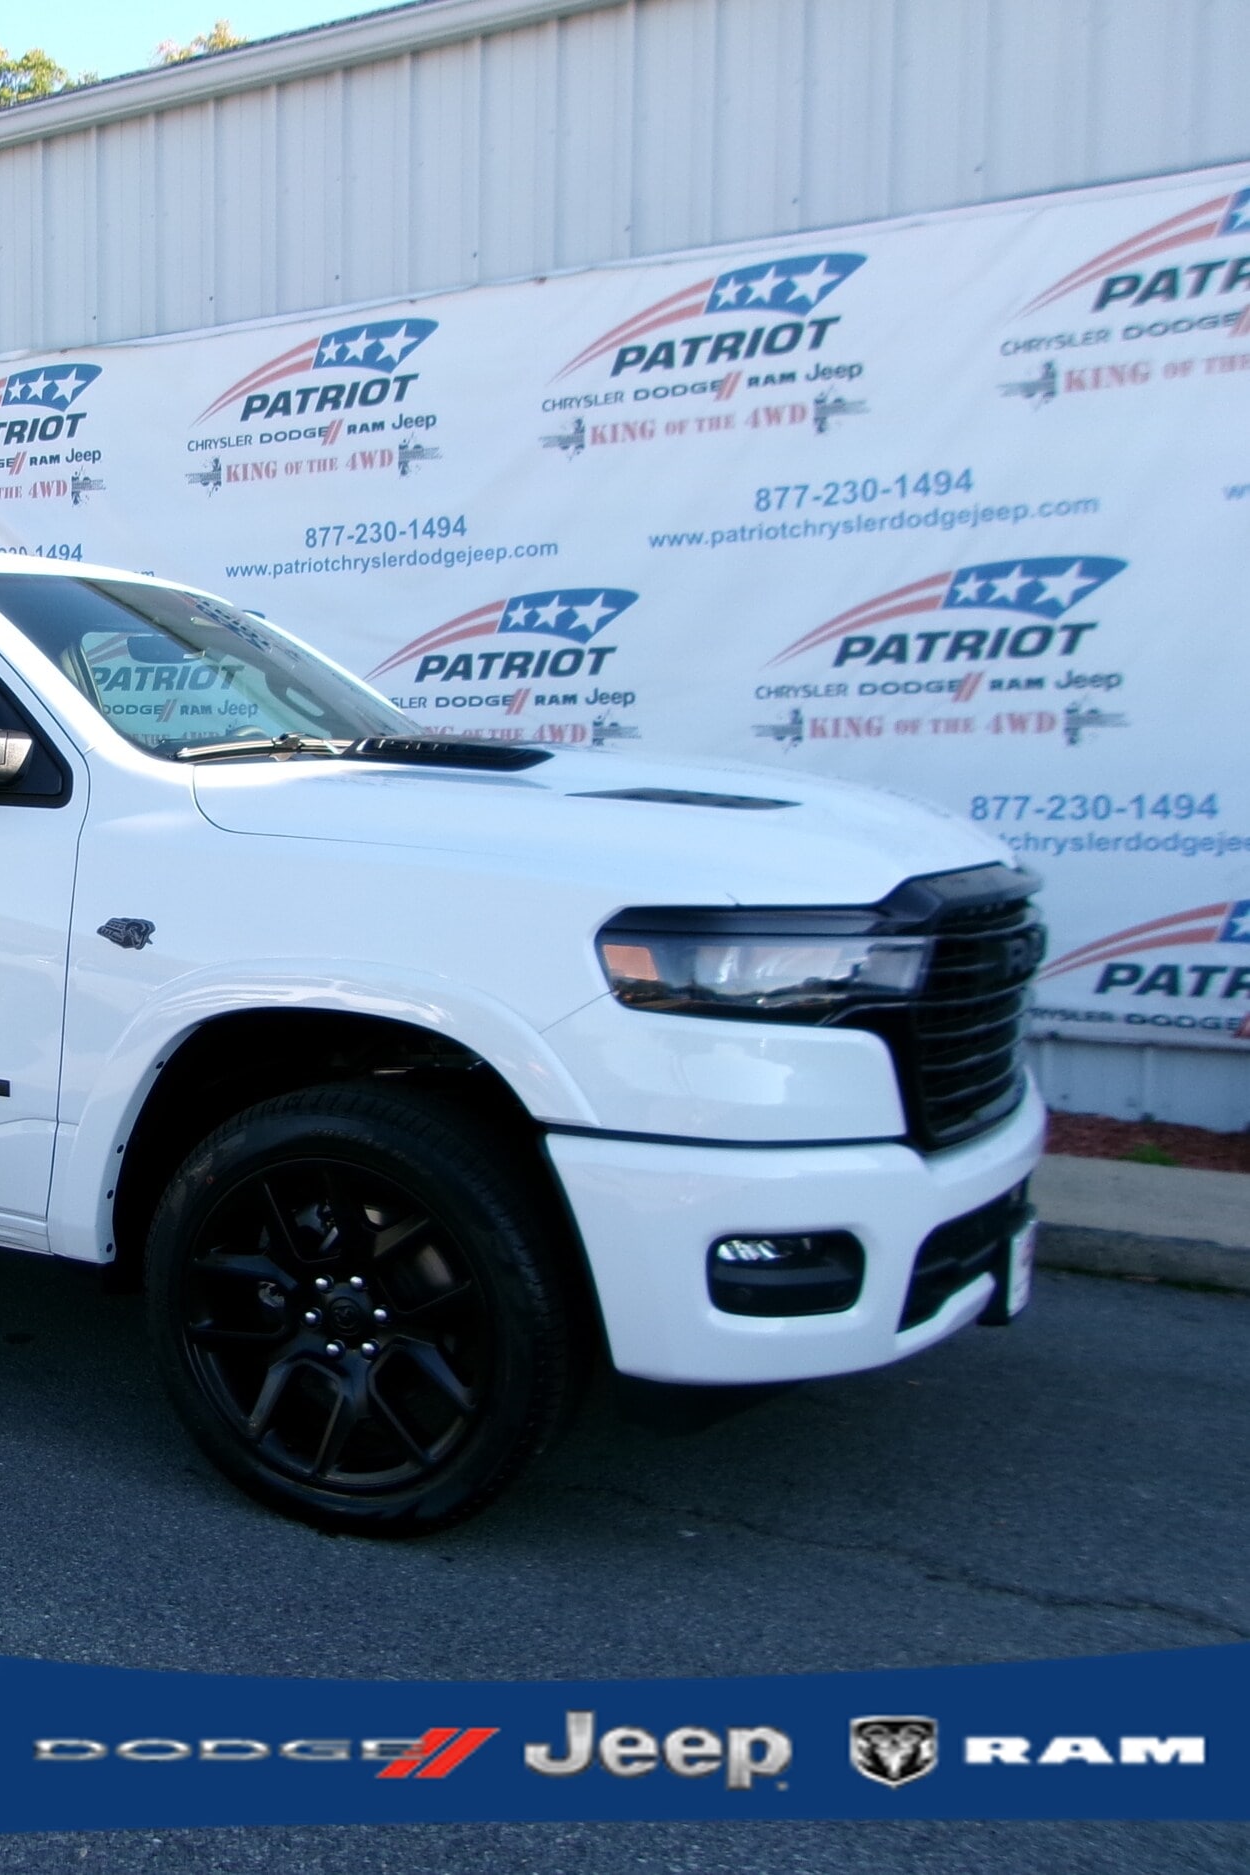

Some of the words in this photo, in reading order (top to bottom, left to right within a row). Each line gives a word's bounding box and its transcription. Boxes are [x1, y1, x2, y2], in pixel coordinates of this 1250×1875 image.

[610, 315, 841, 377] PATRIOT
[1000, 329, 1109, 357] CHRYSLER
[1122, 311, 1242, 341] DODGE
[542, 390, 624, 412] CHRYSLER
[634, 379, 723, 401] DODGE
[747, 371, 796, 388] RAM
[804, 361, 863, 383] Jeep
[1065, 362, 1150, 393] KING
[1162, 360, 1195, 379] OF
[240, 374, 419, 422] PATRIOT
[187, 434, 252, 452] CHRYSLER
[259, 425, 329, 444] DODGE
[347, 420, 385, 435] RAM
[392, 413, 437, 432] Jeep
[590, 419, 655, 446] KING
[664, 419, 690, 437] OF
[695, 413, 736, 433] THE
[744, 403, 808, 431] 4WD
[29, 453, 60, 466] RAM
[65, 449, 101, 464] Jeep
[226, 460, 277, 483] KING
[284, 461, 304, 477] OF
[306, 456, 338, 473] THE
[346, 448, 393, 471] 4WD
[29, 480, 67, 500] 4WD
[755, 468, 973, 513] 877-230-1494
[305, 515, 467, 548] 877-230-1494
[648, 497, 1099, 549] www.patriotchryslerdodgejeep.com
[226, 541, 558, 578] www.patriotchryslerdodgejeep.com
[832, 622, 1099, 668] PATRIOT
[90, 665, 245, 692] PATRIOT
[414, 646, 618, 683] PATRIOT
[435, 693, 514, 708] DODGE
[535, 693, 578, 706] RAM
[584, 687, 635, 708] Jeep
[756, 683, 848, 701] CHRYSLER
[858, 679, 961, 696] DODGE
[989, 676, 1045, 692] RAM
[1054, 670, 1124, 691] Jeep
[103, 704, 164, 715] DODGE
[180, 705, 212, 715] RAM
[218, 700, 258, 718] Jeep
[810, 716, 884, 739] KING
[894, 719, 923, 736] OF
[932, 717, 975, 735] THE
[987, 711, 1057, 736] 4WD
[486, 727, 523, 741] THE
[533, 724, 587, 744] 4WD
[971, 793, 1219, 822] 877-230-1494
[1124, 1013, 1242, 1030] DODGE
